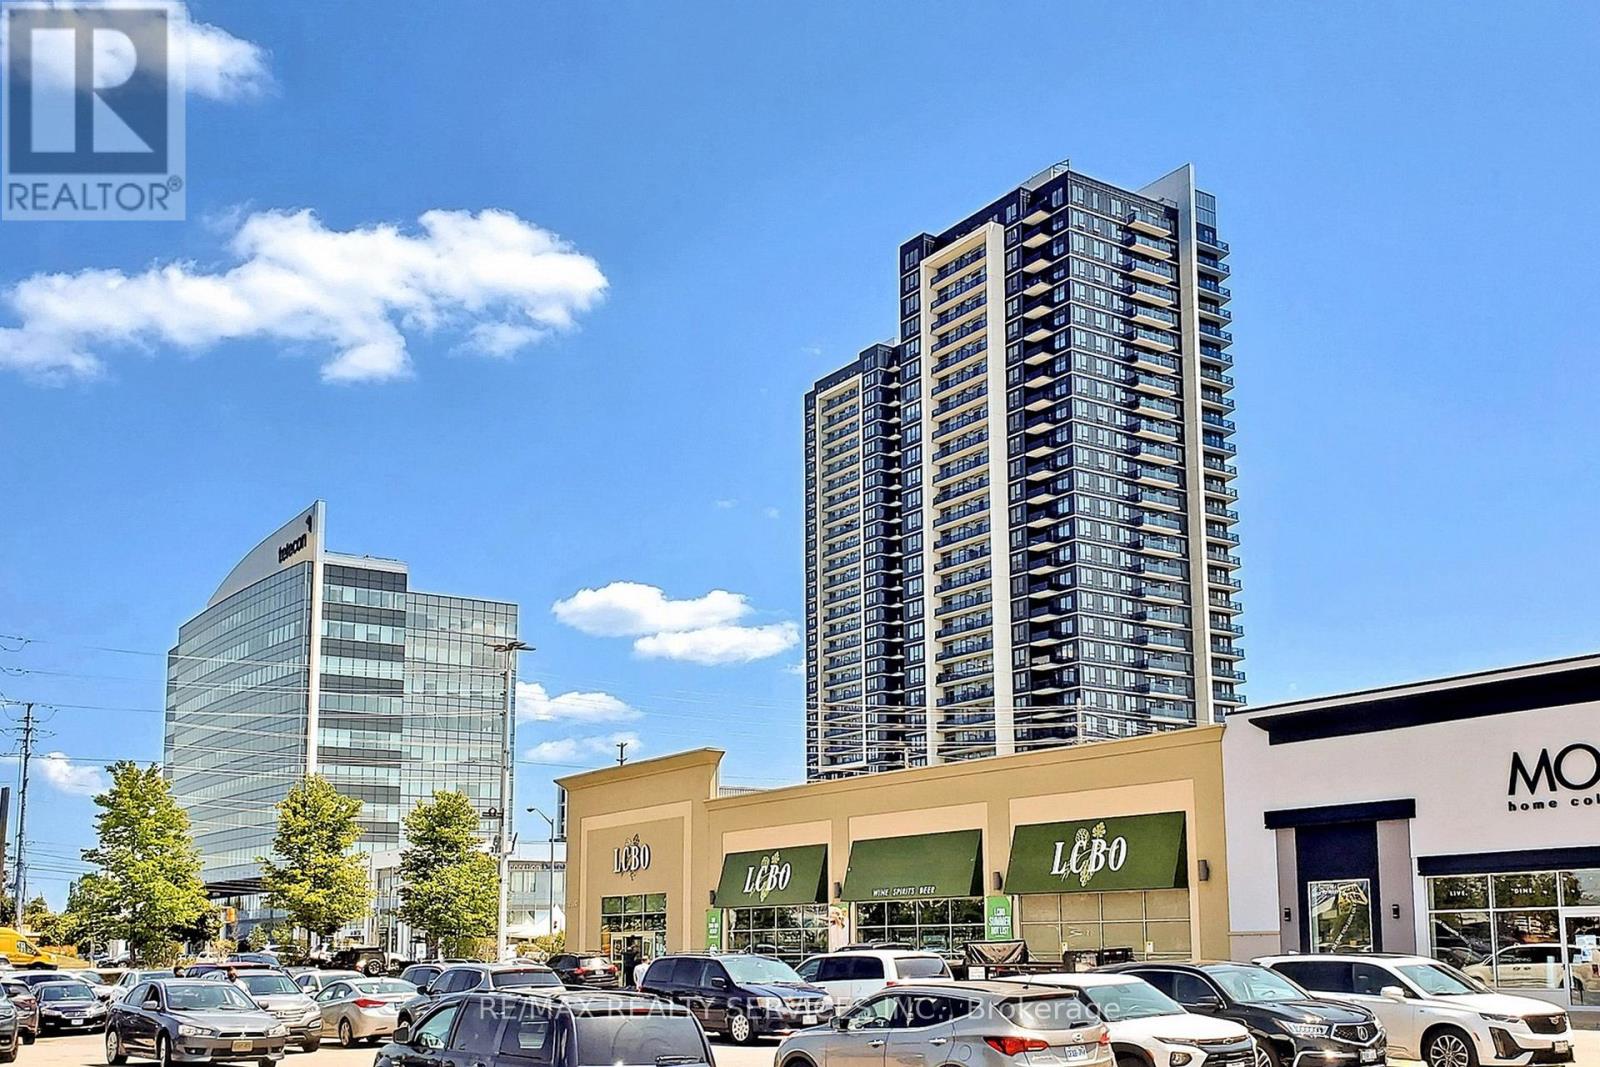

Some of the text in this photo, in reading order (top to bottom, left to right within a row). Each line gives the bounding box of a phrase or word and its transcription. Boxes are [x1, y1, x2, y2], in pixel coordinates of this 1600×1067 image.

[279, 534, 307, 563] telecon
[1508, 801, 1557, 811] home
[613, 844, 651, 874] LCBO
[1050, 836, 1127, 875] LCBO
[743, 862, 791, 893] LCBO
[873, 885, 936, 897] WINE SPIRITS BEER
